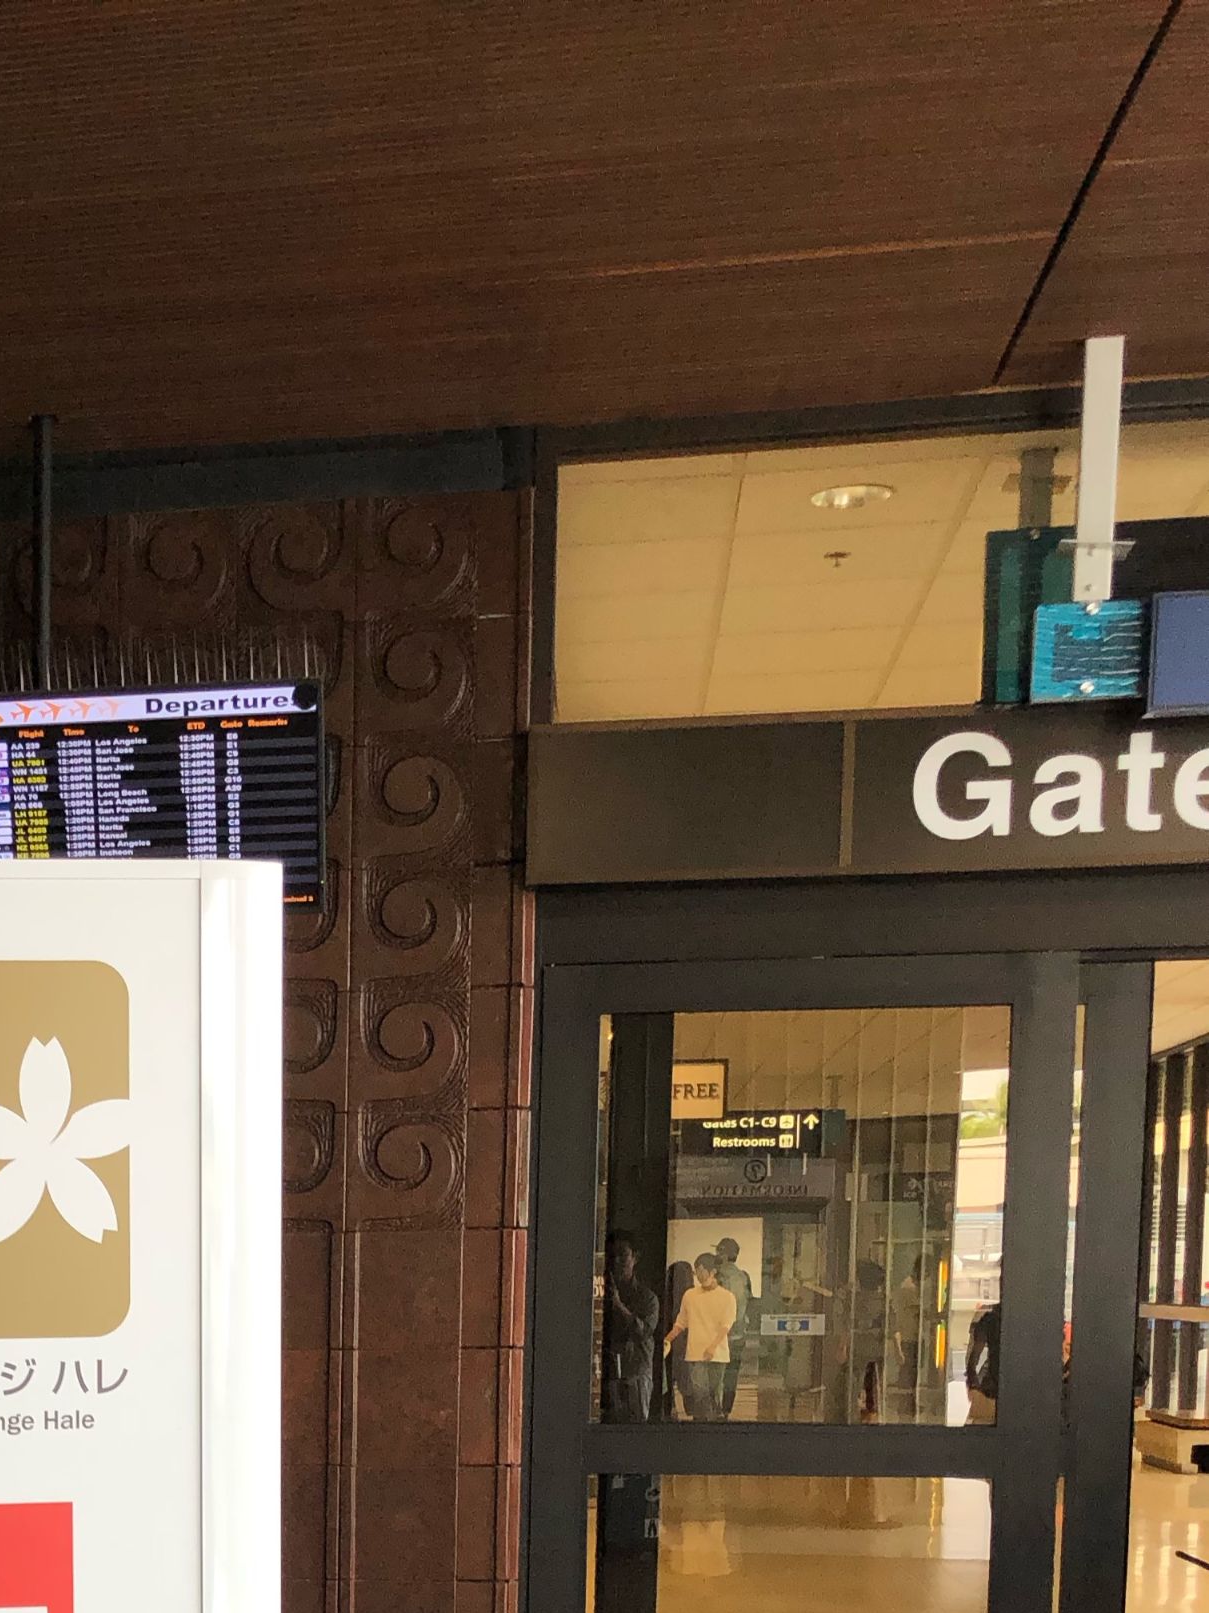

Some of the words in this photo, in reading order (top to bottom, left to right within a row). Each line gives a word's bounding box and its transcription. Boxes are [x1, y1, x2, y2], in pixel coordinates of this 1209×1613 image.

[145, 696, 295, 715] Departure
[187, 722, 205, 730] ETD
[113, 738, 147, 747] Angeles
[913, 732, 1209, 840] Gate
[116, 798, 149, 806] Angeles
[117, 840, 150, 848] Angeles
[673, 1083, 719, 1099] FREE
[713, 1137, 776, 1148] Restrooms
[52, 1358, 128, 1395] ハレ
[44, 1410, 94, 1430] Hale
